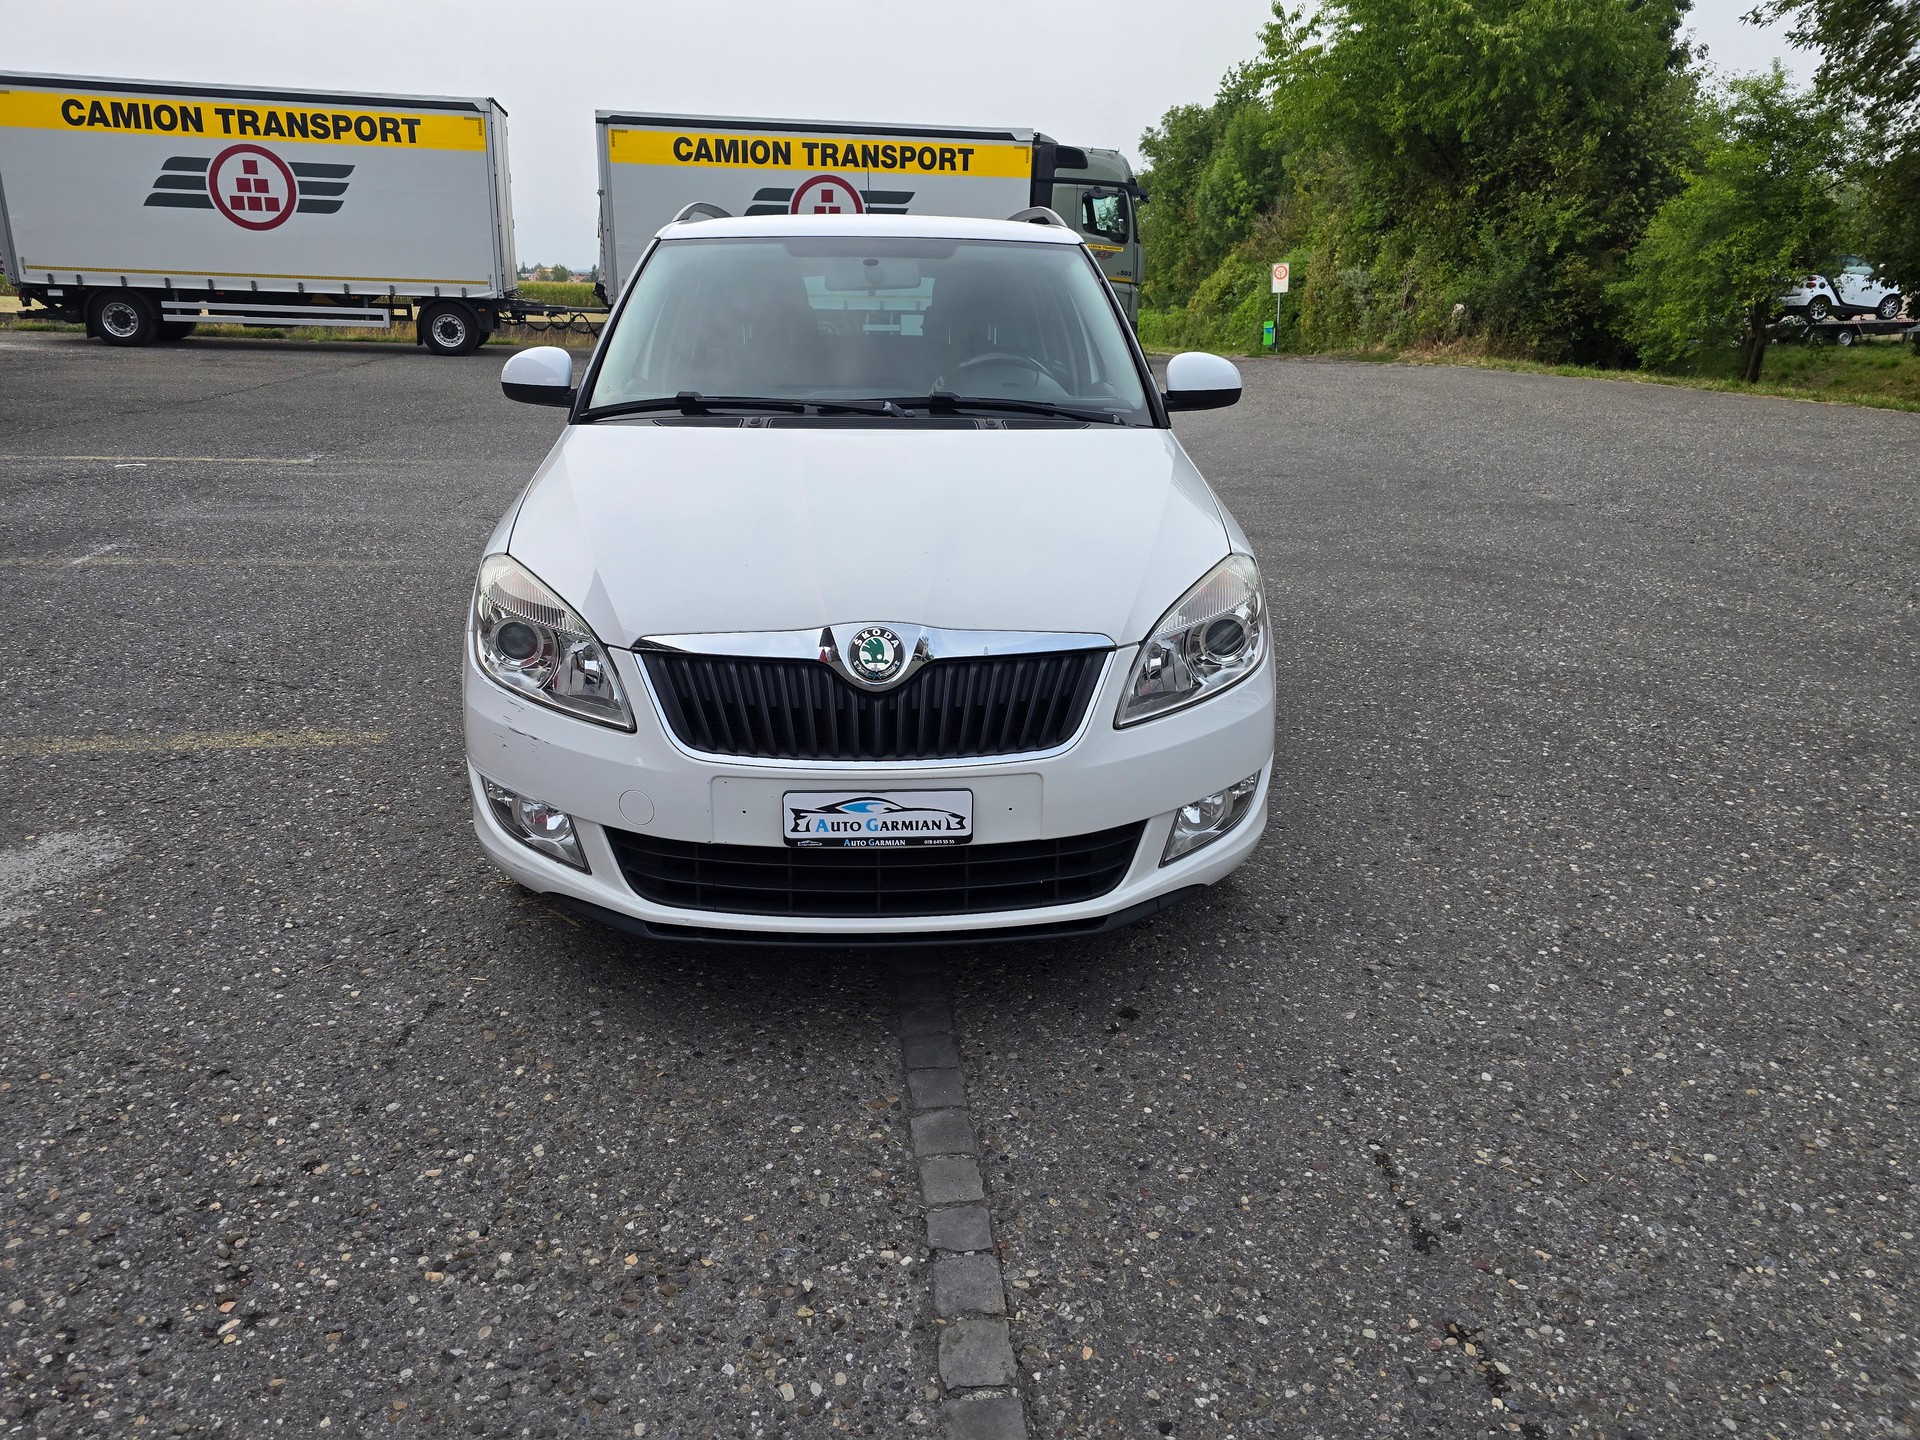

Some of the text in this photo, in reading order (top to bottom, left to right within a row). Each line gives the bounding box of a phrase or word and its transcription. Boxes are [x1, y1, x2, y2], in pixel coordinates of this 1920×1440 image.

[61, 98, 421, 143] CAMION TRANSPORT
[673, 137, 974, 171] CAMION TRANSPORT
